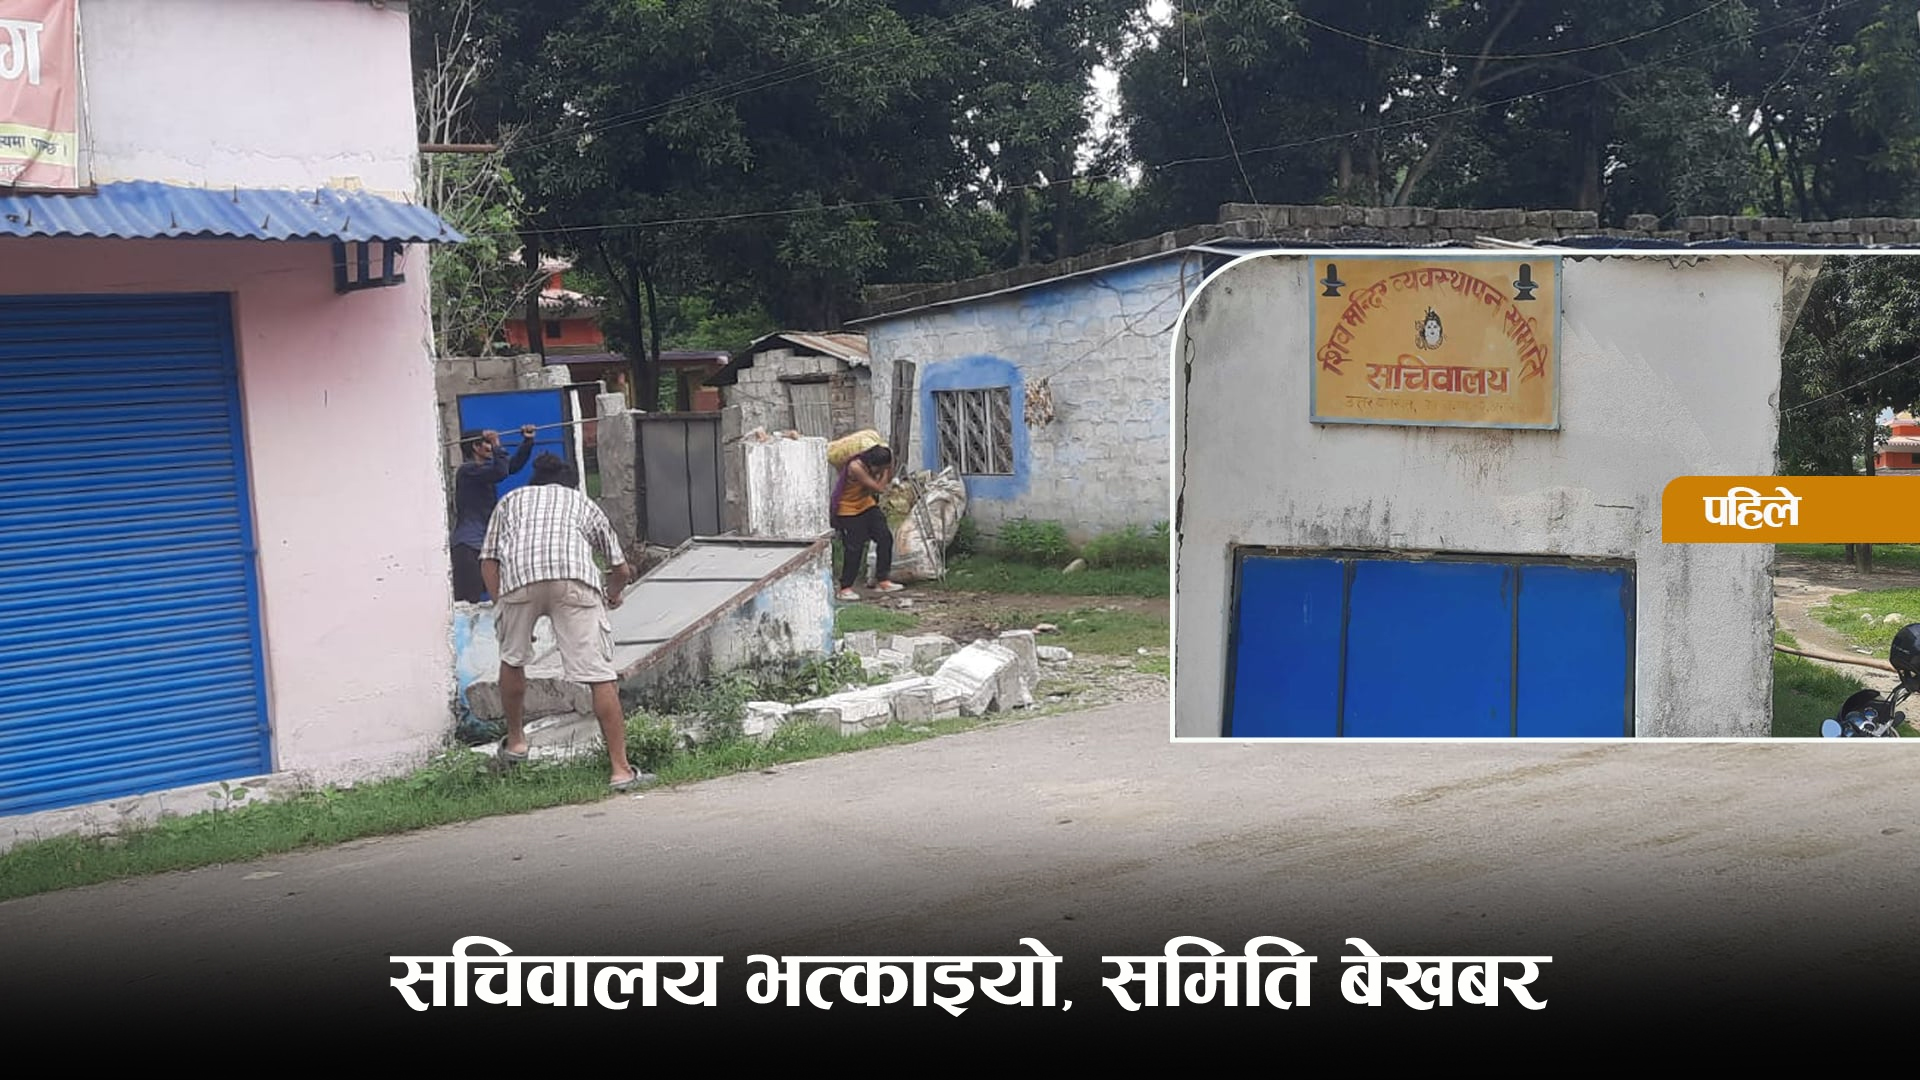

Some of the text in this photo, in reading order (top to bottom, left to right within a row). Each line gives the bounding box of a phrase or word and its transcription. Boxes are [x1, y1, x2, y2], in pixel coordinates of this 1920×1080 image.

[1317, 267, 1548, 384] शिव मन्दिर व्यवस्थापन समिति
[1366, 353, 1511, 396] सचिवालय
